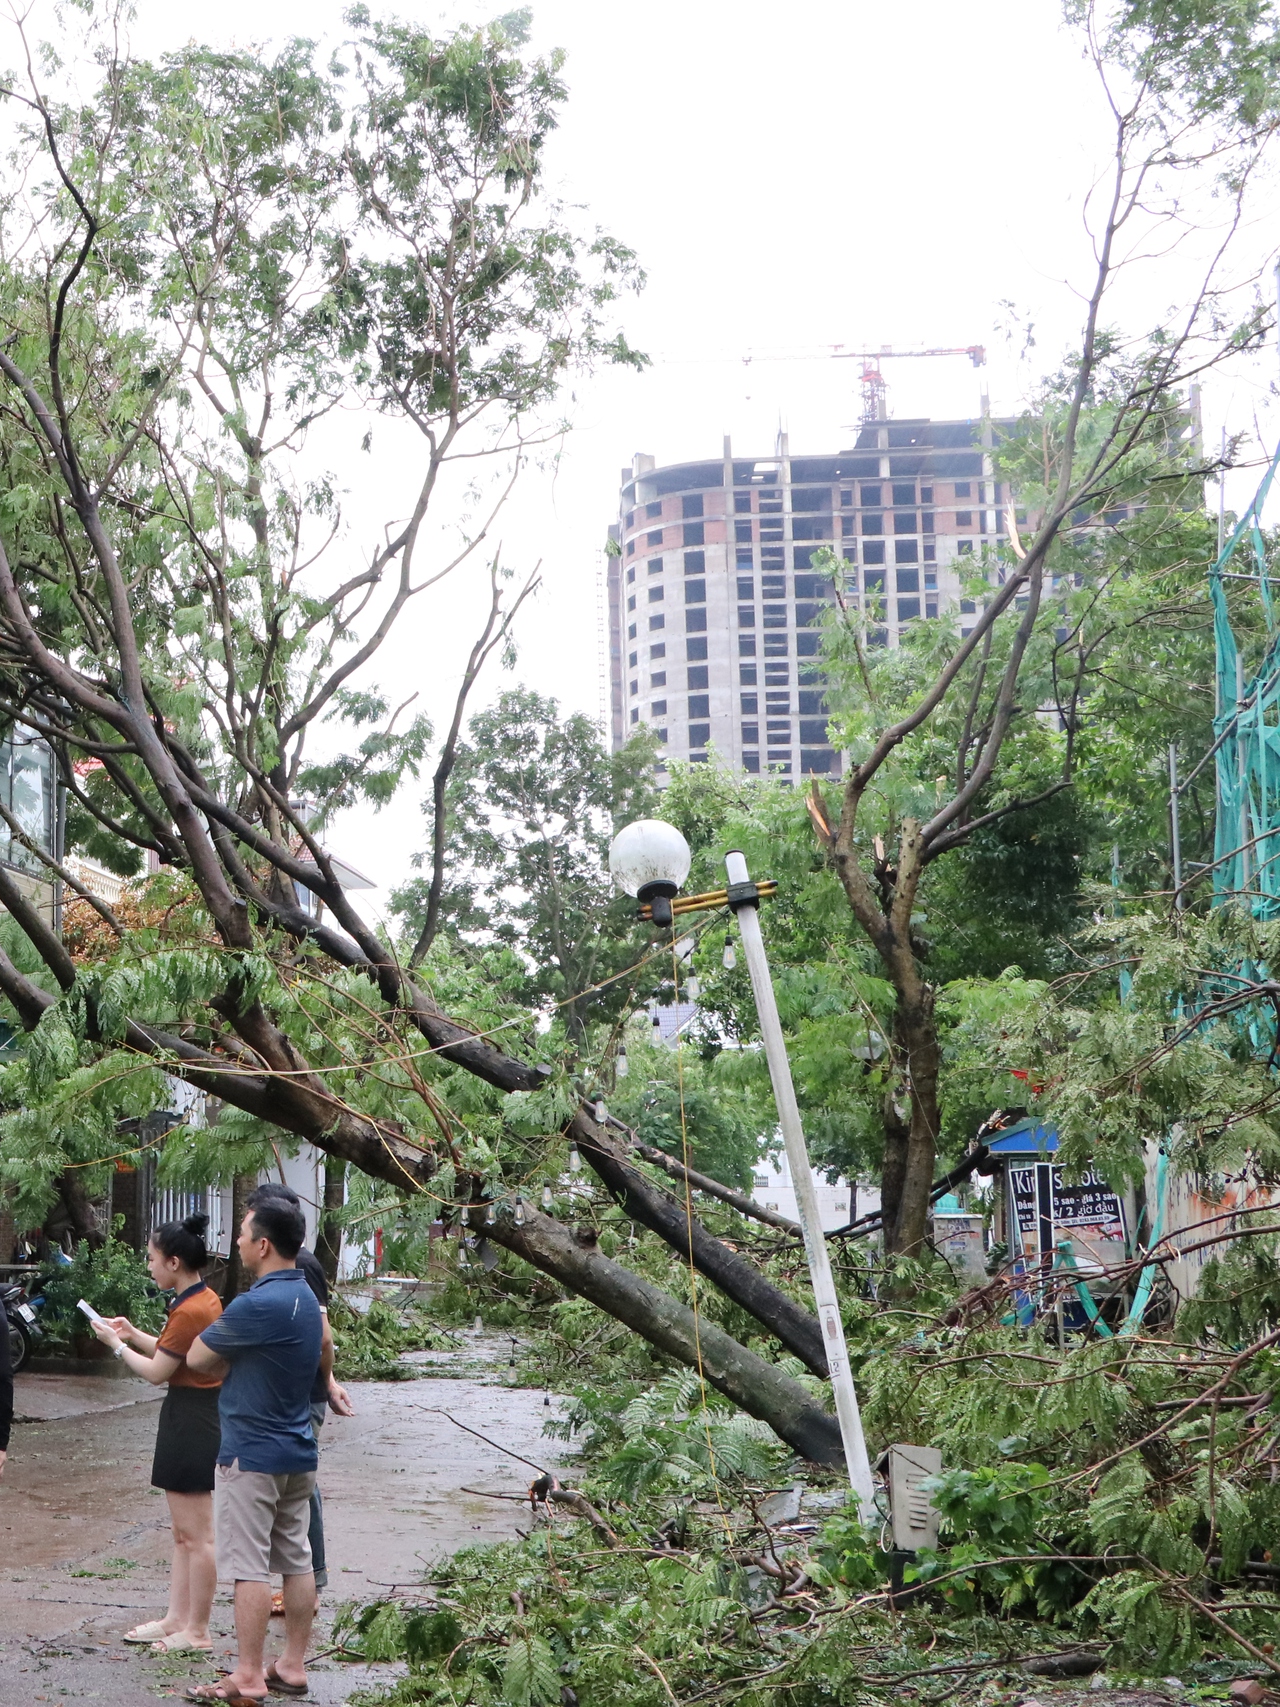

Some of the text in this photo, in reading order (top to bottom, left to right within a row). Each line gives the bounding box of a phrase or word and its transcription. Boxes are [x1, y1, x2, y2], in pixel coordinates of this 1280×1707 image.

[1062, 1196, 1074, 1205] sao
[1096, 1192, 1101, 1201] 3
[1066, 1207, 1074, 1216] 2
